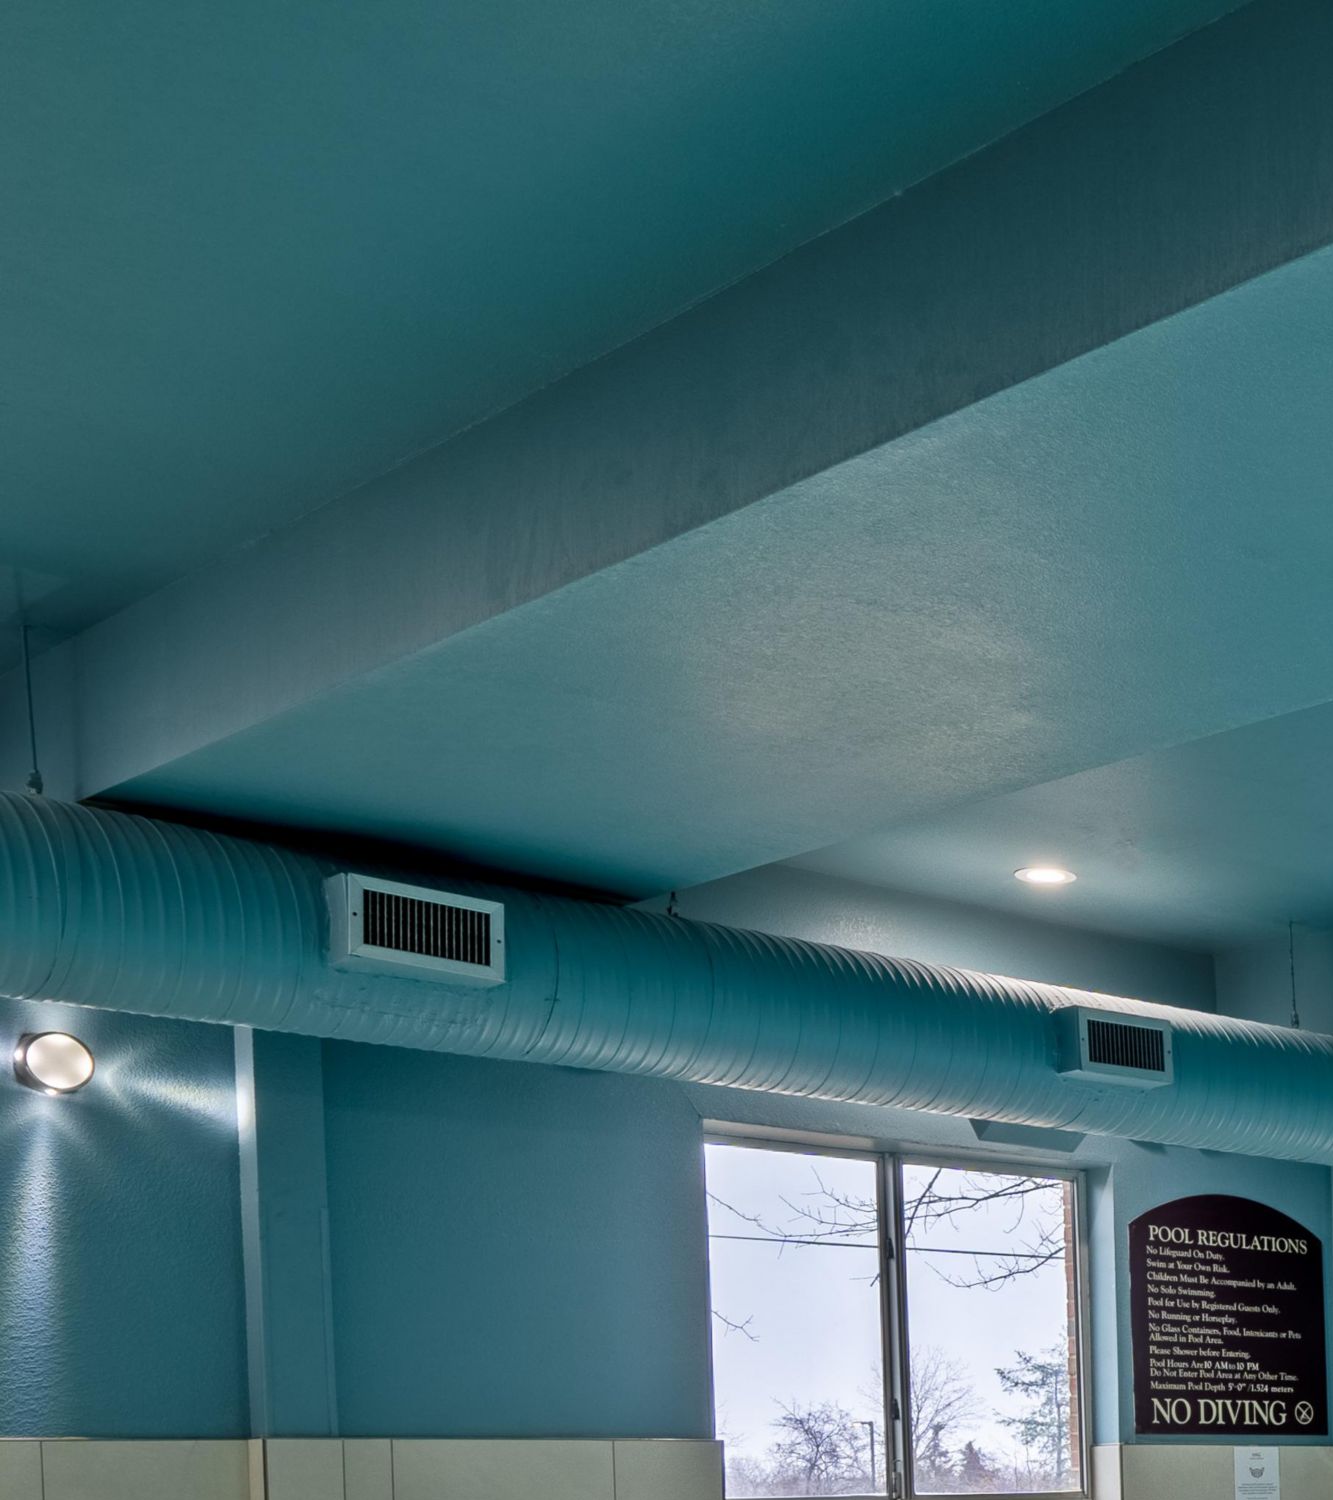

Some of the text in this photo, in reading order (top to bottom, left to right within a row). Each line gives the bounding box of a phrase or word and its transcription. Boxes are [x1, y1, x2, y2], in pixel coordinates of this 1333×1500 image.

[1148, 1225, 1308, 1255] POOL REGULATIONS
[1146, 1245, 1225, 1261] No Lifeguard On Duty.
[1146, 1258, 1166, 1268] Swim
[1176, 1260, 1192, 1270] Your
[1194, 1262, 1211, 1272] Own
[1212, 1263, 1230, 1273] Risk.
[1146, 1271, 1178, 1282] Children
[1180, 1273, 1198, 1283] Must
[1199, 1275, 1209, 1284] Be
[1210, 1276, 1256, 1288] Accompanied
[1257, 1280, 1265, 1290] by
[1147, 1284, 1216, 1298] No Solo Swimming.
[1147, 1297, 1164, 1306] Pool
[1165, 1298, 1175, 1307] for
[1176, 1299, 1190, 1308] Use
[1191, 1300, 1200, 1309] by
[1201, 1301, 1237, 1311] Registered
[1238, 1303, 1260, 1312] Guests
[1148, 1310, 1160, 1319] No
[1161, 1310, 1192, 1322] Running
[1148, 1322, 1160, 1332] No
[1161, 1323, 1180, 1333] Glass
[1243, 1328, 1278, 1338] Intoxicants
[1288, 1330, 1301, 1339] Pets
[1149, 1333, 1177, 1342] Allowed
[1179, 1334, 1187, 1342] in
[1188, 1334, 1203, 1343] Pool
[1149, 1345, 1171, 1355] Please
[1172, 1346, 1198, 1356] Shower
[1199, 1347, 1220, 1357] before
[1149, 1358, 1165, 1367] Pool
[1167, 1359, 1189, 1368] Hours
[1191, 1360, 1203, 1368] Are
[1204, 1360, 1212, 1369] 10
[1215, 1361, 1228, 1370] AM
[1236, 1362, 1244, 1370] 10
[1246, 1362, 1259, 1371] PM
[1150, 1368, 1161, 1377] Do
[1163, 1369, 1177, 1377] Not
[1179, 1369, 1198, 1378] Enter
[1199, 1370, 1214, 1378] Pool
[1216, 1371, 1233, 1379] Area
[1243, 1371, 1257, 1381] Any
[1258, 1371, 1278, 1380] Other
[1150, 1380, 1186, 1390] Maximum
[1187, 1382, 1203, 1391] Pool
[1204, 1382, 1226, 1392] Depth
[1151, 1398, 1287, 1426] NO DIVING
